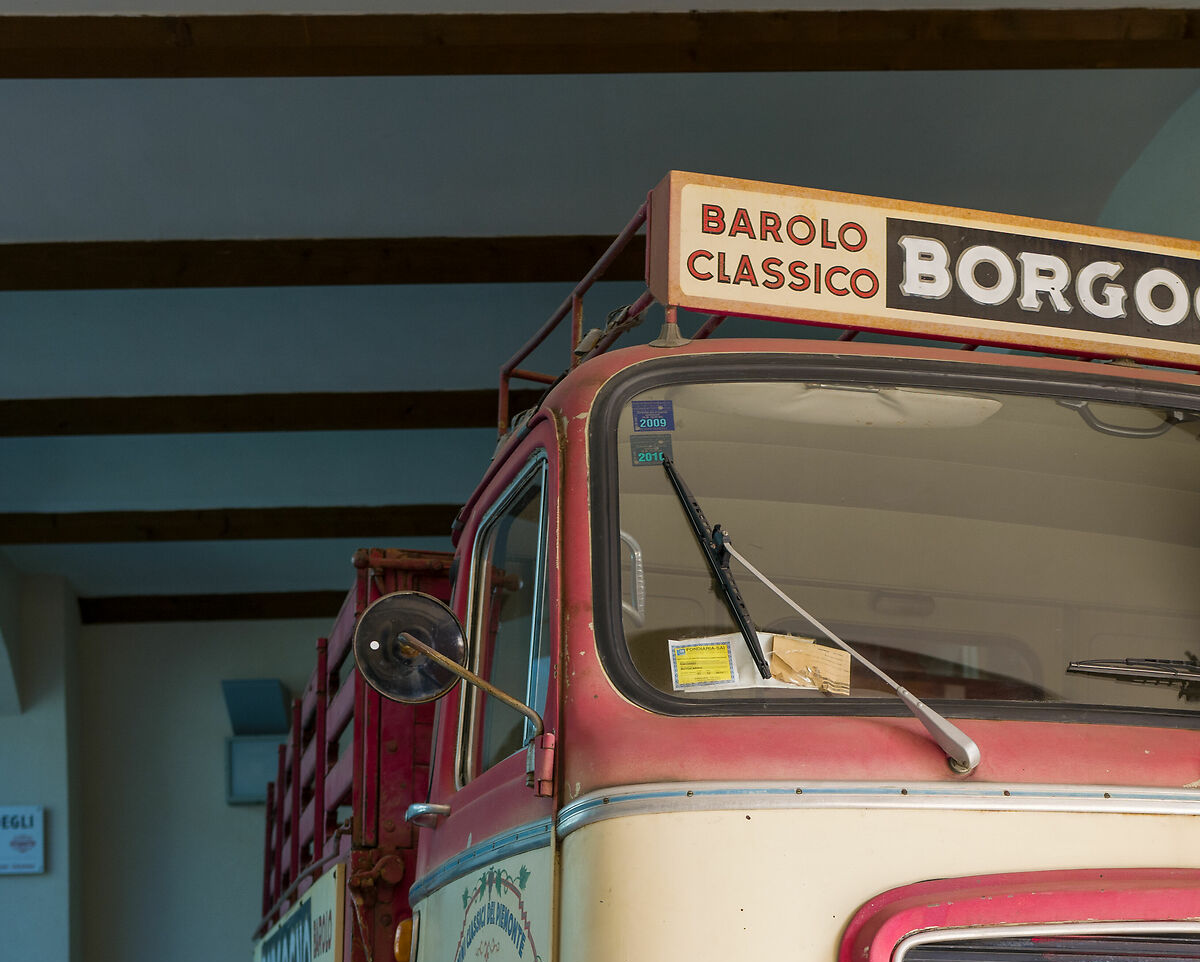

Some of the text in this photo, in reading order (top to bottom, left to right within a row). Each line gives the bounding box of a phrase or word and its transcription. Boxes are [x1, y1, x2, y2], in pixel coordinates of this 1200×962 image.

[702, 203, 867, 252] BAROLO
[687, 249, 879, 299] CLASSICO
[639, 418, 667, 428] 2009
[0, 814, 34, 830] EGLI
[496, 902, 526, 958] PIEMONTE
